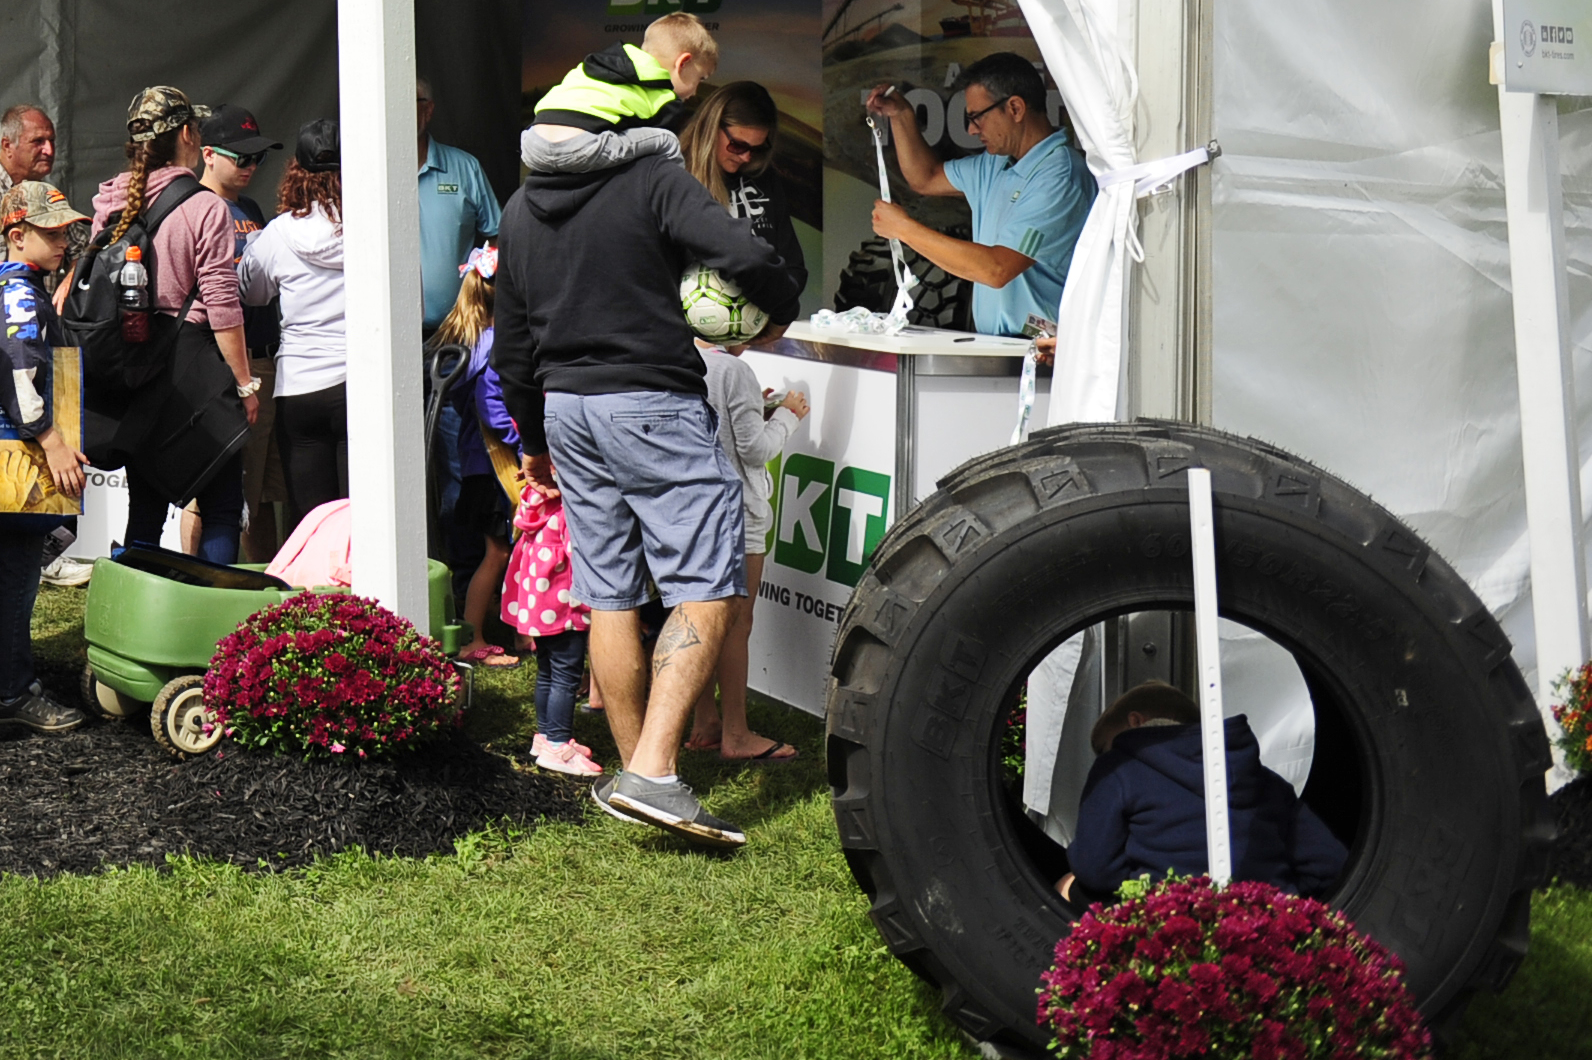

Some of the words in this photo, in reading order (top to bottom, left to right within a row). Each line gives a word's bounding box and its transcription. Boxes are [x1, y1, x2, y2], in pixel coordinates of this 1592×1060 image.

[604, 23, 649, 33] GROWIN
[794, 592, 856, 624] TOGET
[916, 633, 983, 757] BKT
